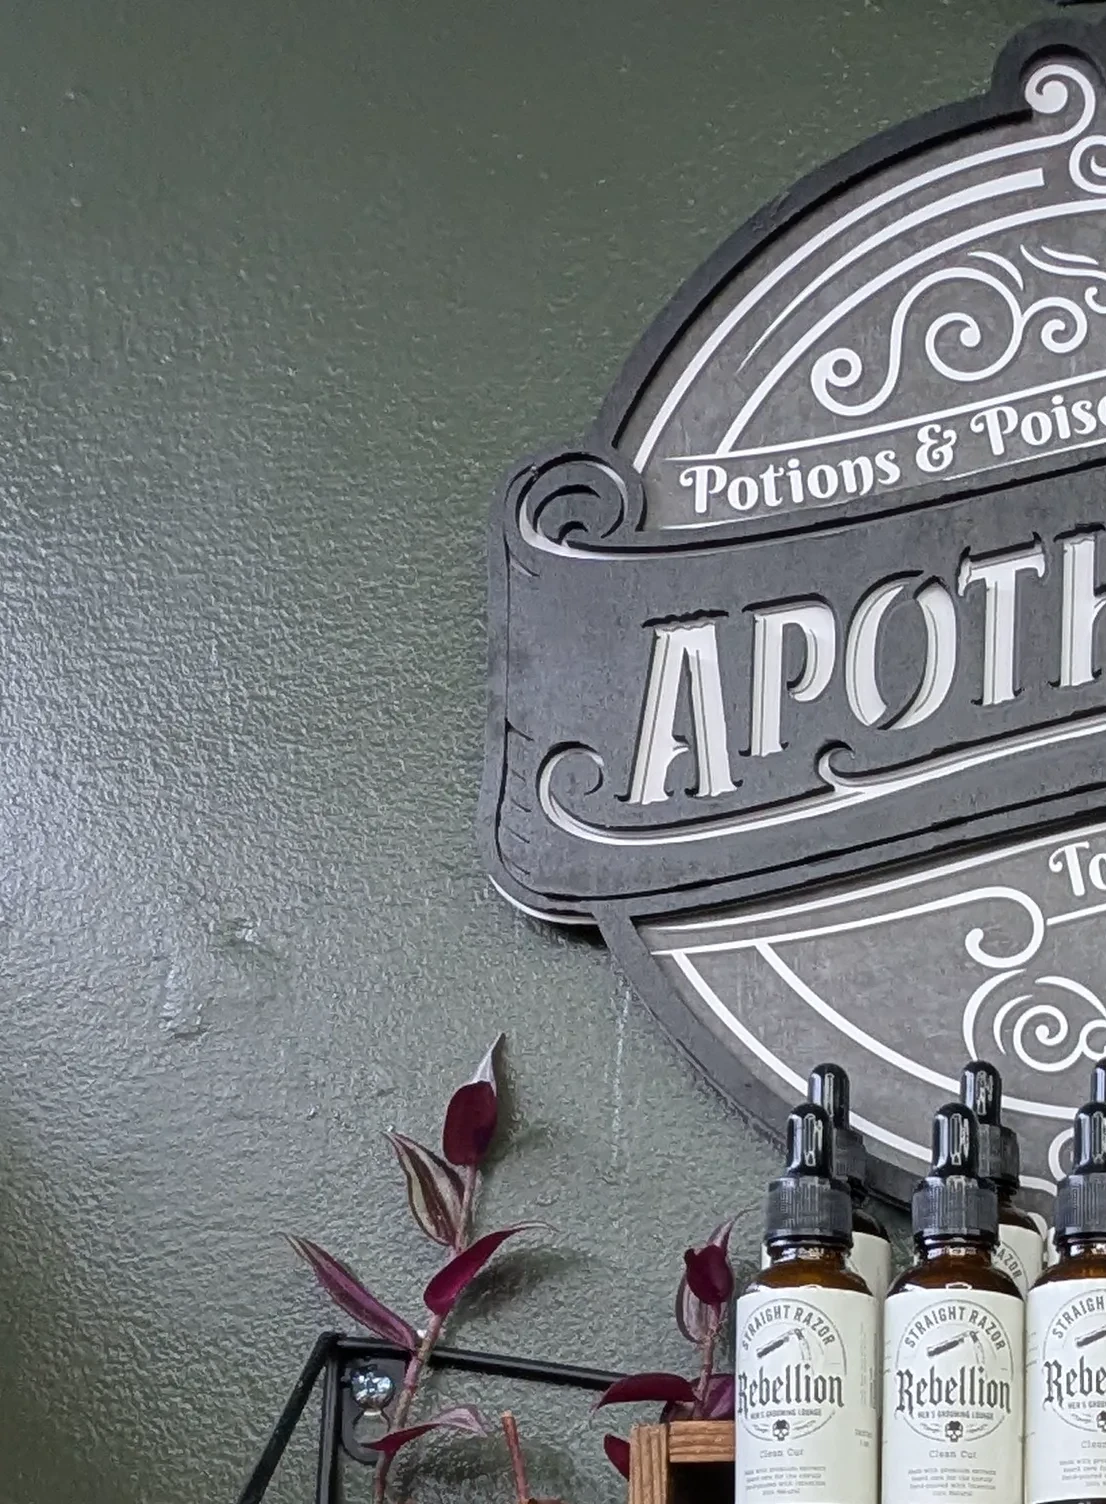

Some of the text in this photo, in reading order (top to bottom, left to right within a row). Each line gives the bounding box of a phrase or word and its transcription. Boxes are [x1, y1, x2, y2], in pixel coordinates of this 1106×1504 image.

[680, 448, 901, 513] Potions
[916, 424, 958, 473] &
[743, 1305, 835, 1350] STRAIGHT RAZOR
[906, 1306, 1006, 1351] STRAIGHT RAZOR
[739, 1364, 844, 1418] Rebellion
[896, 1365, 1011, 1418] Rebellion
[760, 1448, 803, 1458] Clean Cut
[929, 1450, 956, 1458] Clean
